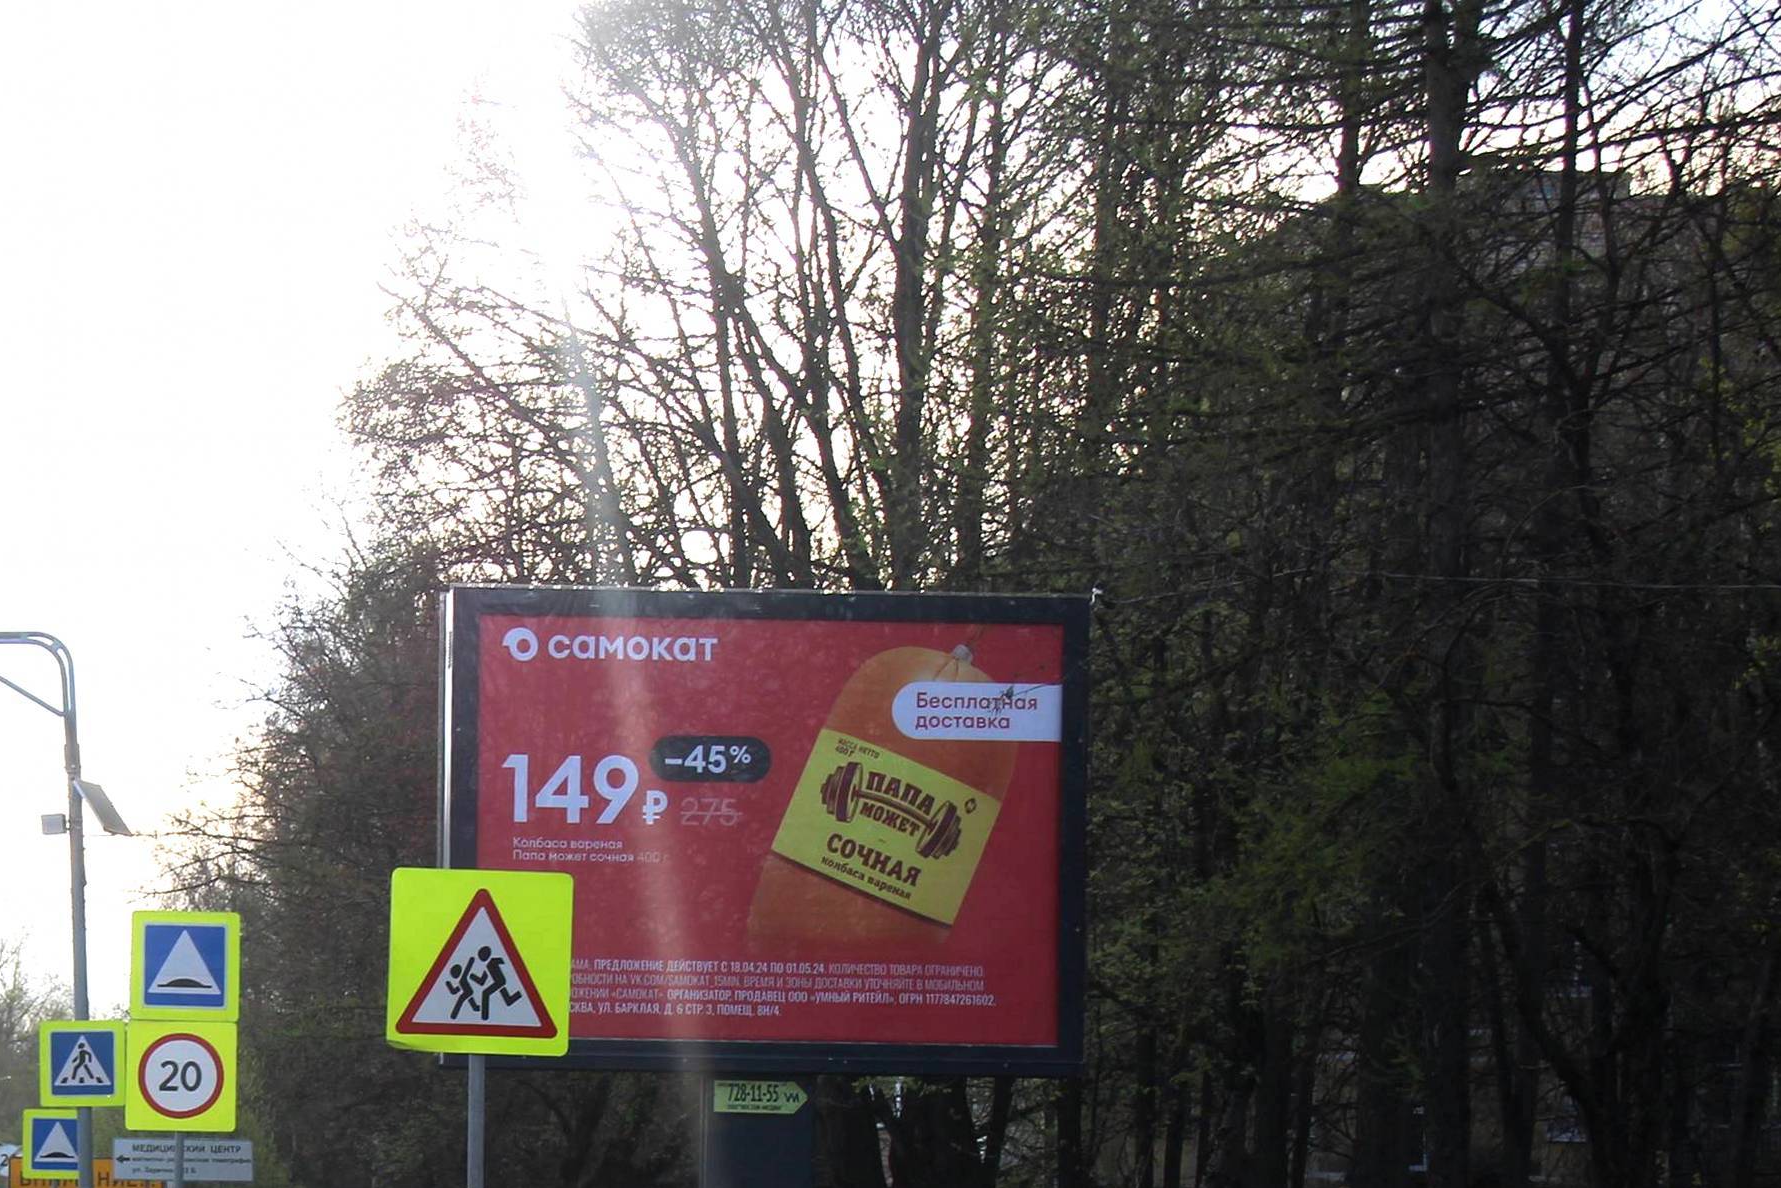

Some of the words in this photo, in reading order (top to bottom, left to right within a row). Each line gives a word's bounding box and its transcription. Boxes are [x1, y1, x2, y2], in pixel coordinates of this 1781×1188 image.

[547, 634, 718, 662] самокат
[916, 691, 1038, 710] Бесплатная
[915, 715, 1011, 730] доставка
[665, 744, 752, 774] -45%
[866, 771, 936, 816] ПАПА
[680, 798, 744, 826] 275
[859, 801, 921, 838] МОЖЕТ
[512, 836, 568, 849] Колбаса
[570, 838, 623, 850] вареная
[512, 850, 546, 862] Папа
[548, 851, 587, 862] может
[589, 852, 635, 863] сочная
[826, 832, 922, 888] СОЧНАЯ
[821, 856, 866, 881] колбаса
[867, 875, 912, 900] вареная
[594, 959, 664, 971] ПРЕДЛОЖЕНИЕ
[667, 959, 719, 973] ДЕЙСТВУЕТ
[721, 962, 727, 973] С
[770, 963, 784, 974] ПО
[829, 963, 887, 976] КОЛИЧЕСТВО
[889, 964, 923, 976] ТОВАРА
[571, 974, 615, 985] ОБНОСТИ
[814, 978, 862, 989] ДОСТАВКИ
[925, 980, 984, 990] МОБИЛЬНОМ
[571, 988, 609, 998] ОЖЕНИИ
[734, 990, 786, 1002] ПРОДАВЕЦ
[787, 991, 808, 1002] ООО
[898, 993, 923, 1005] ОГРН
[598, 1003, 613, 1014] УЛ.
[676, 1005, 684, 1014] 6
[159, 1060, 202, 1092] 20
[132, 1143, 206, 1153] МЕДИЦИСКИЙ
[210, 1144, 242, 1154] ЦЕНТР
